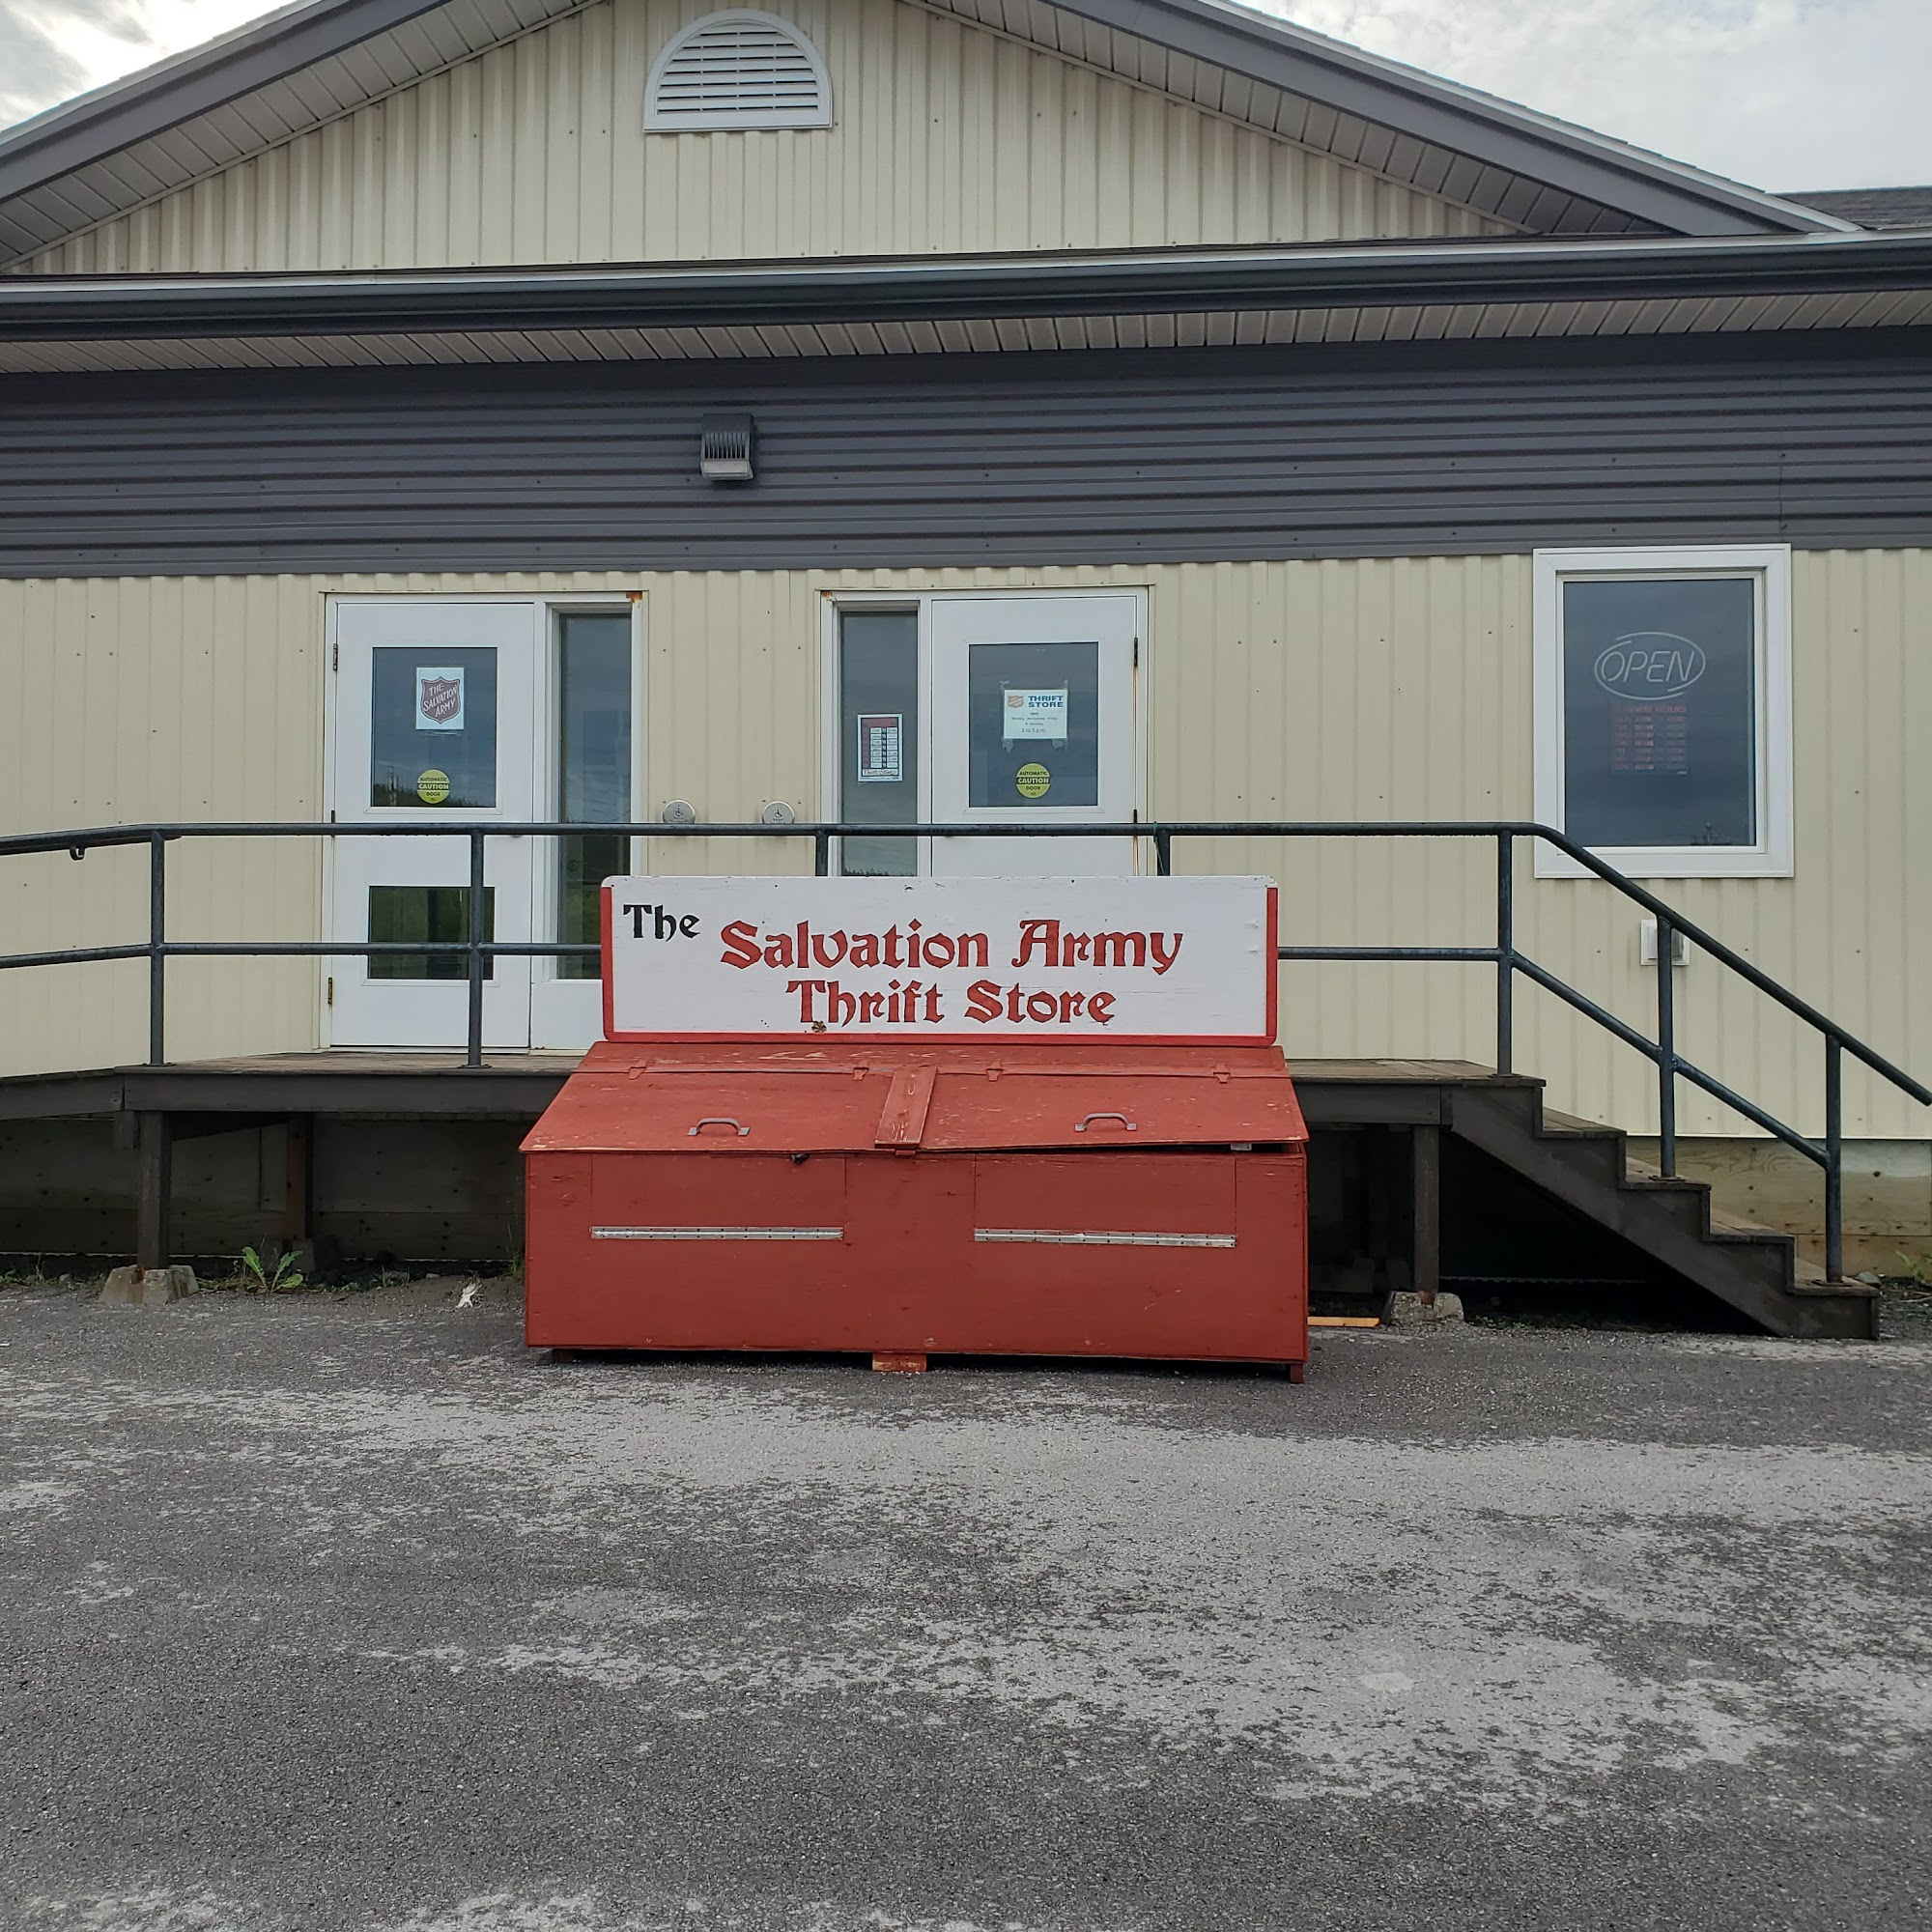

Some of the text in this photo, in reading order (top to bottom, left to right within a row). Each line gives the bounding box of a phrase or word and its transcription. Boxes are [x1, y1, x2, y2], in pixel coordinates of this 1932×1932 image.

[1601, 650, 1695, 683] OPEN
[423, 684, 457, 712] SALVATION
[429, 683, 444, 696] THE
[435, 697, 456, 717] ARMY
[623, 904, 1184, 976] The Salvation Army
[785, 979, 1118, 1028] Thrift Store
